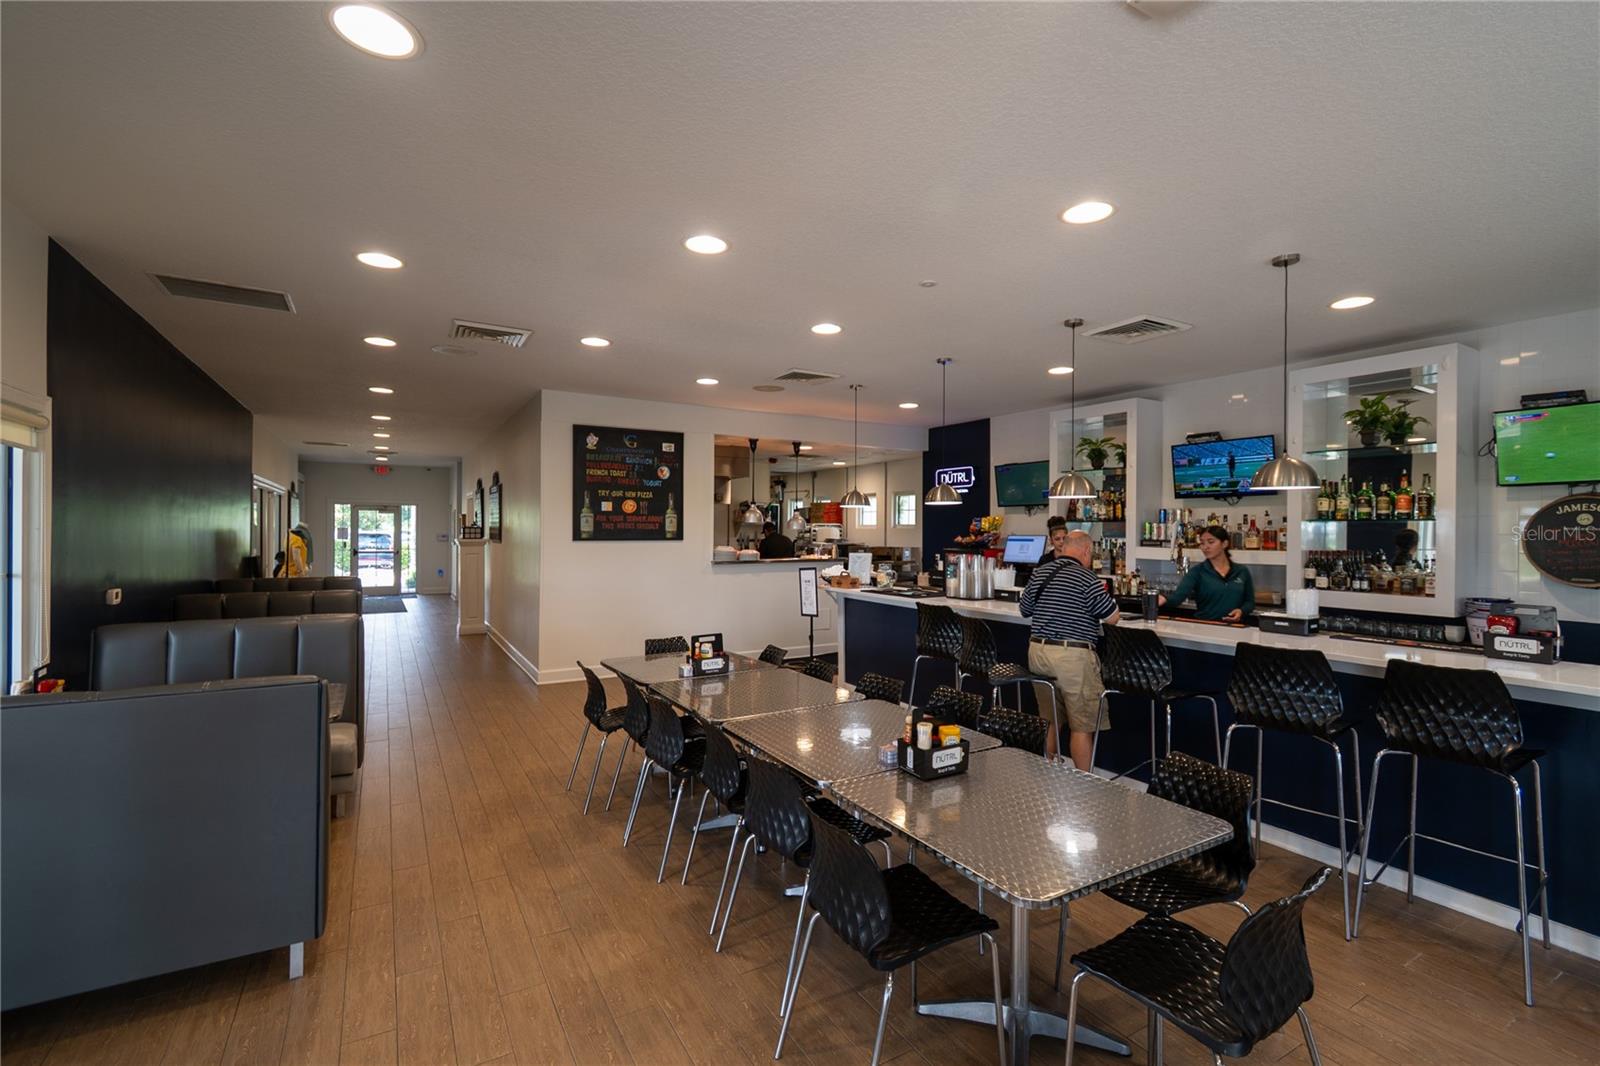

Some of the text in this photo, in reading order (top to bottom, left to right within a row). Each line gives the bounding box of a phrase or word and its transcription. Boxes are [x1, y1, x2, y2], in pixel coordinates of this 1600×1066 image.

[586, 468, 627, 477] FRENCH TOAST
[637, 491, 653, 499] PIZZA
